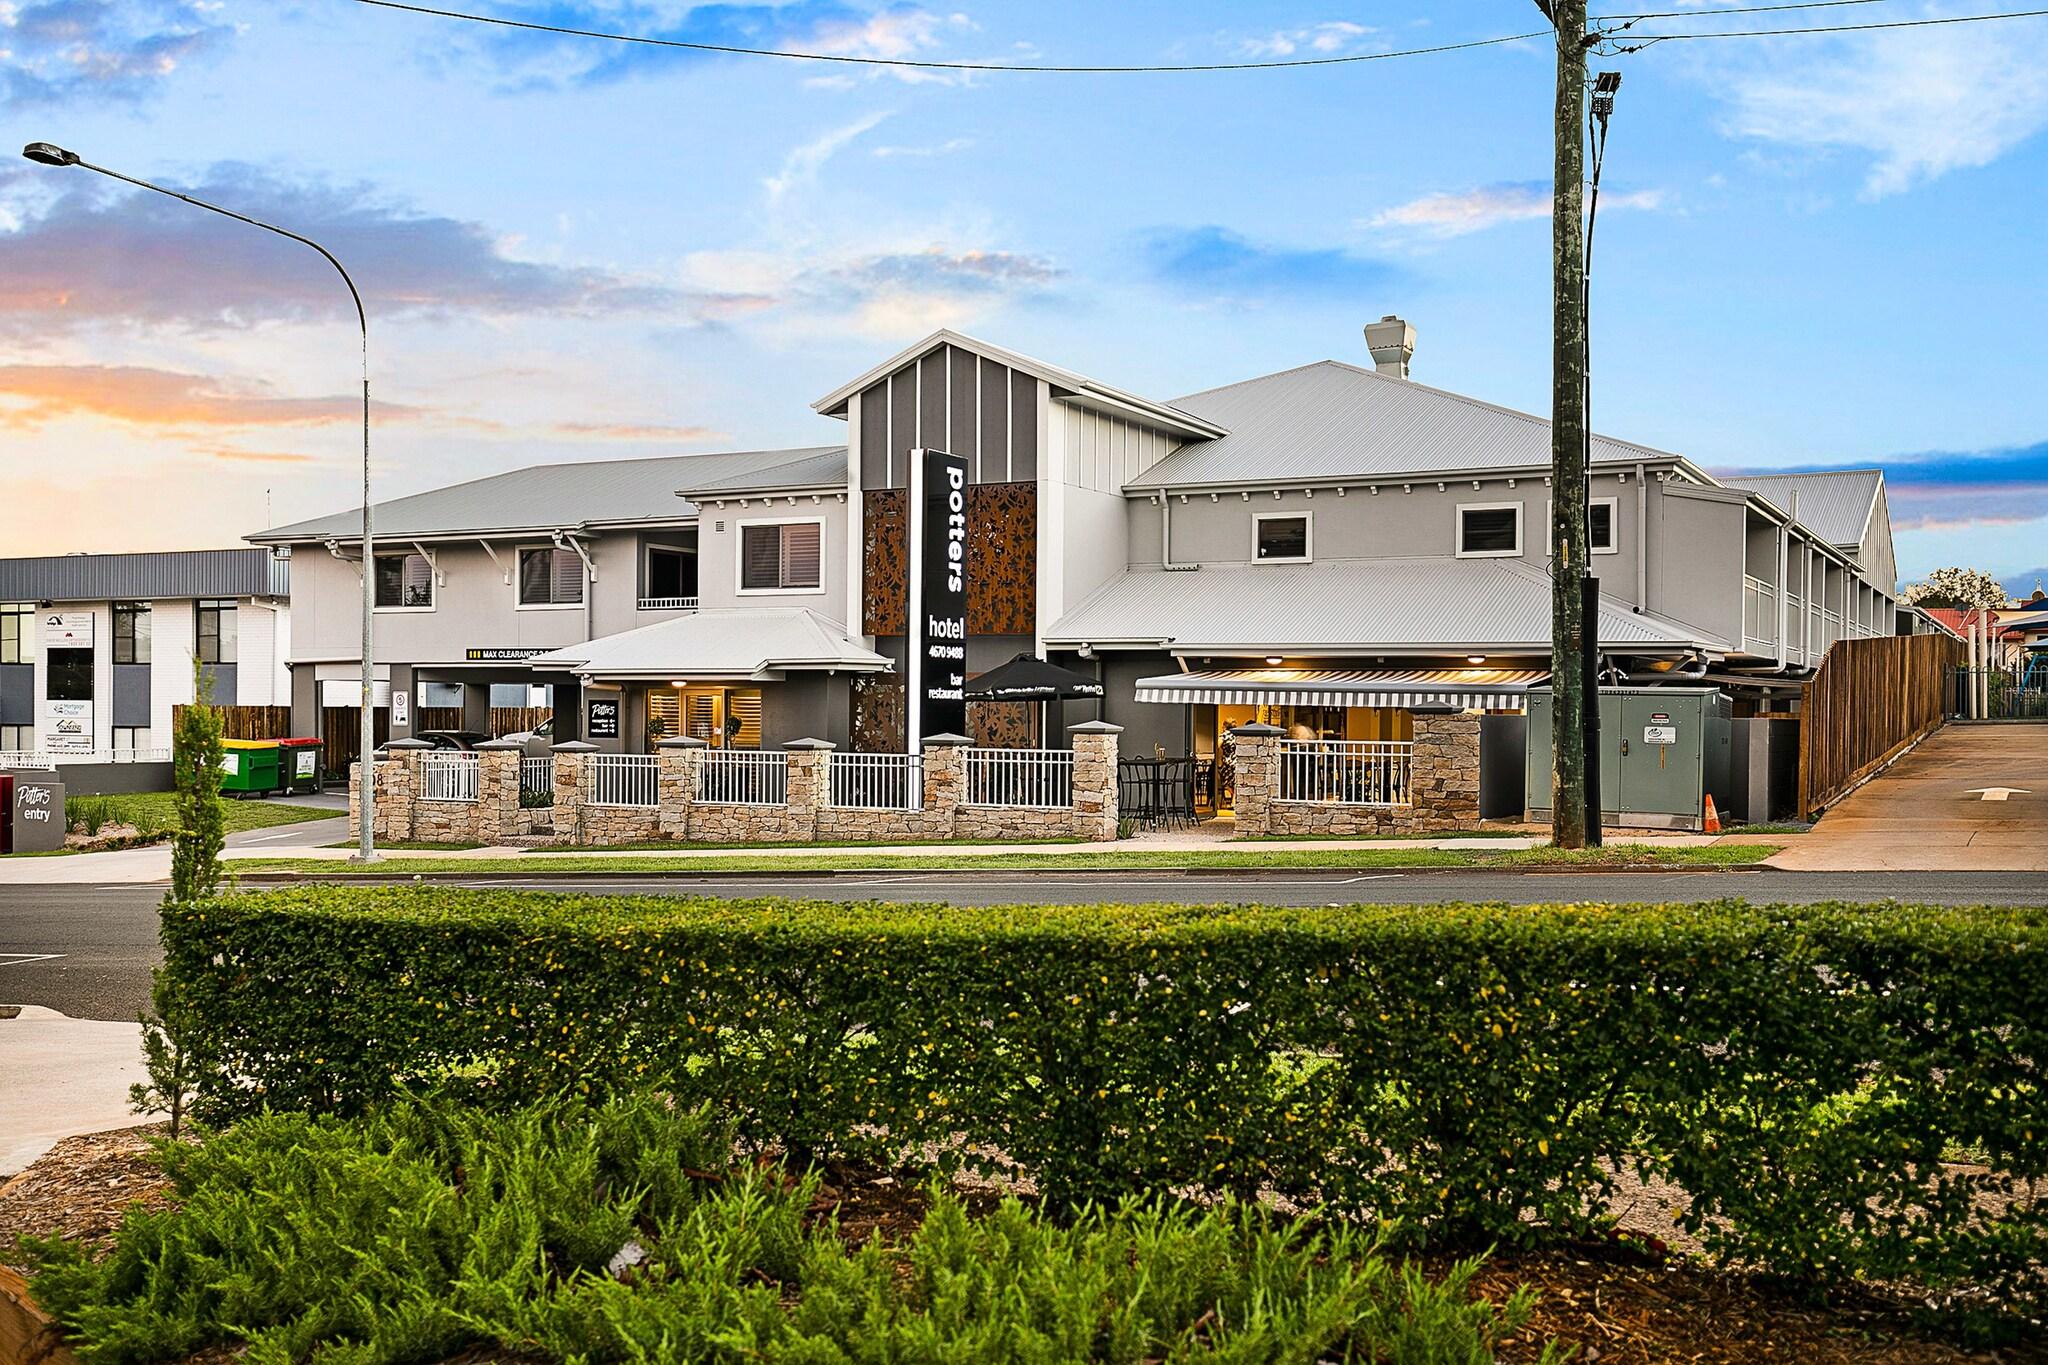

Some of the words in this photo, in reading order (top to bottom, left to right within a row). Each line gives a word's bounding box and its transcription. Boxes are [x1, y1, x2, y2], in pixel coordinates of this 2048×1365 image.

[946, 466, 965, 592] potters
[929, 614, 964, 639] hotel
[483, 650, 497, 658] MAX
[498, 650, 538, 659] CLEARANCE
[929, 645, 946, 658] 4670
[946, 647, 964, 659] 9488
[950, 673, 963, 686] bar
[928, 688, 963, 700] restaurant
[24, 808, 50, 822] entry
